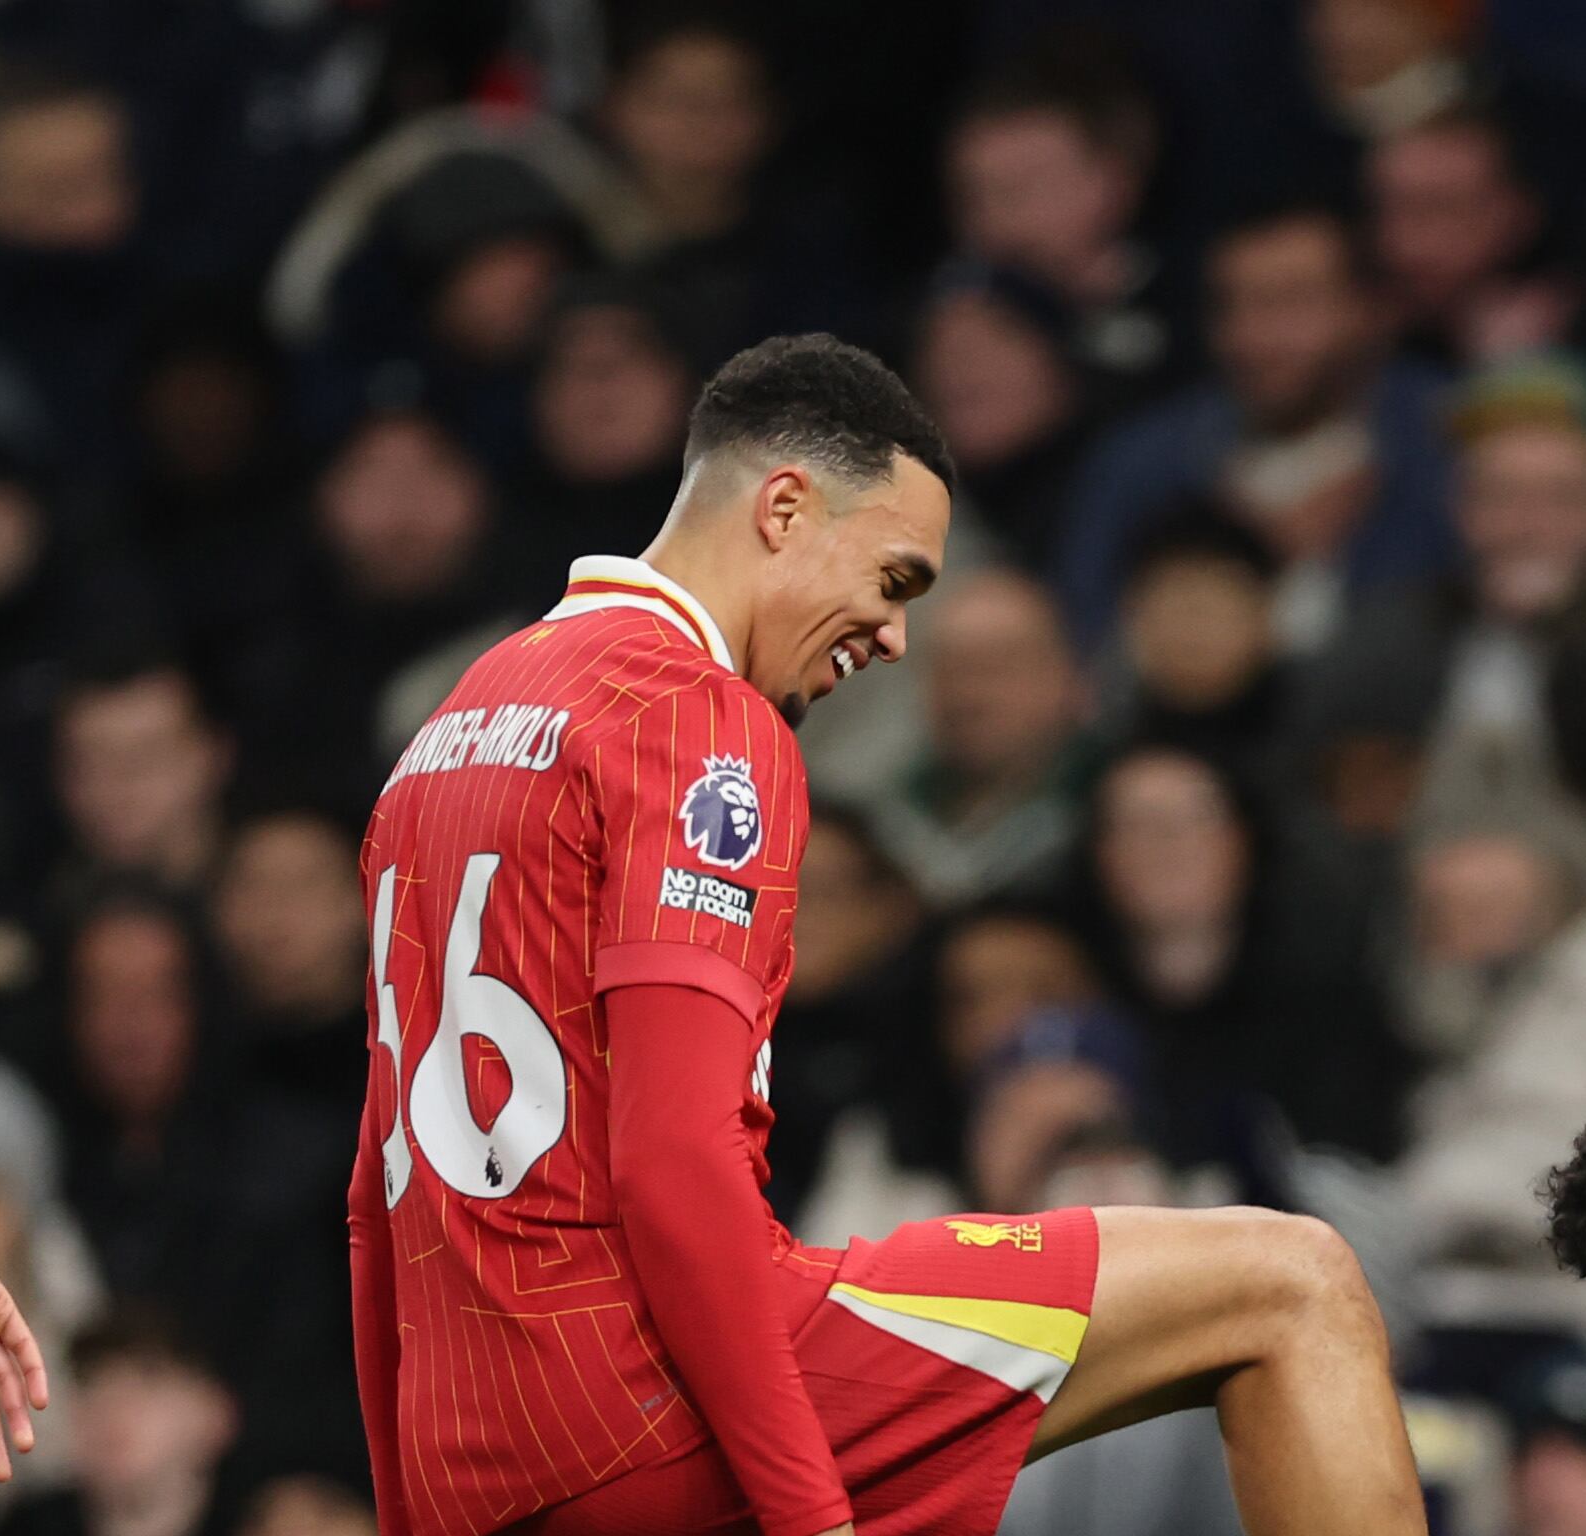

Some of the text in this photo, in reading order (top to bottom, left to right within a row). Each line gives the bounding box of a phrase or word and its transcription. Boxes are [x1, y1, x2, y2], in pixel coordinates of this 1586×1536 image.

[659, 885, 752, 929] for racism
[662, 866, 748, 909] No room
